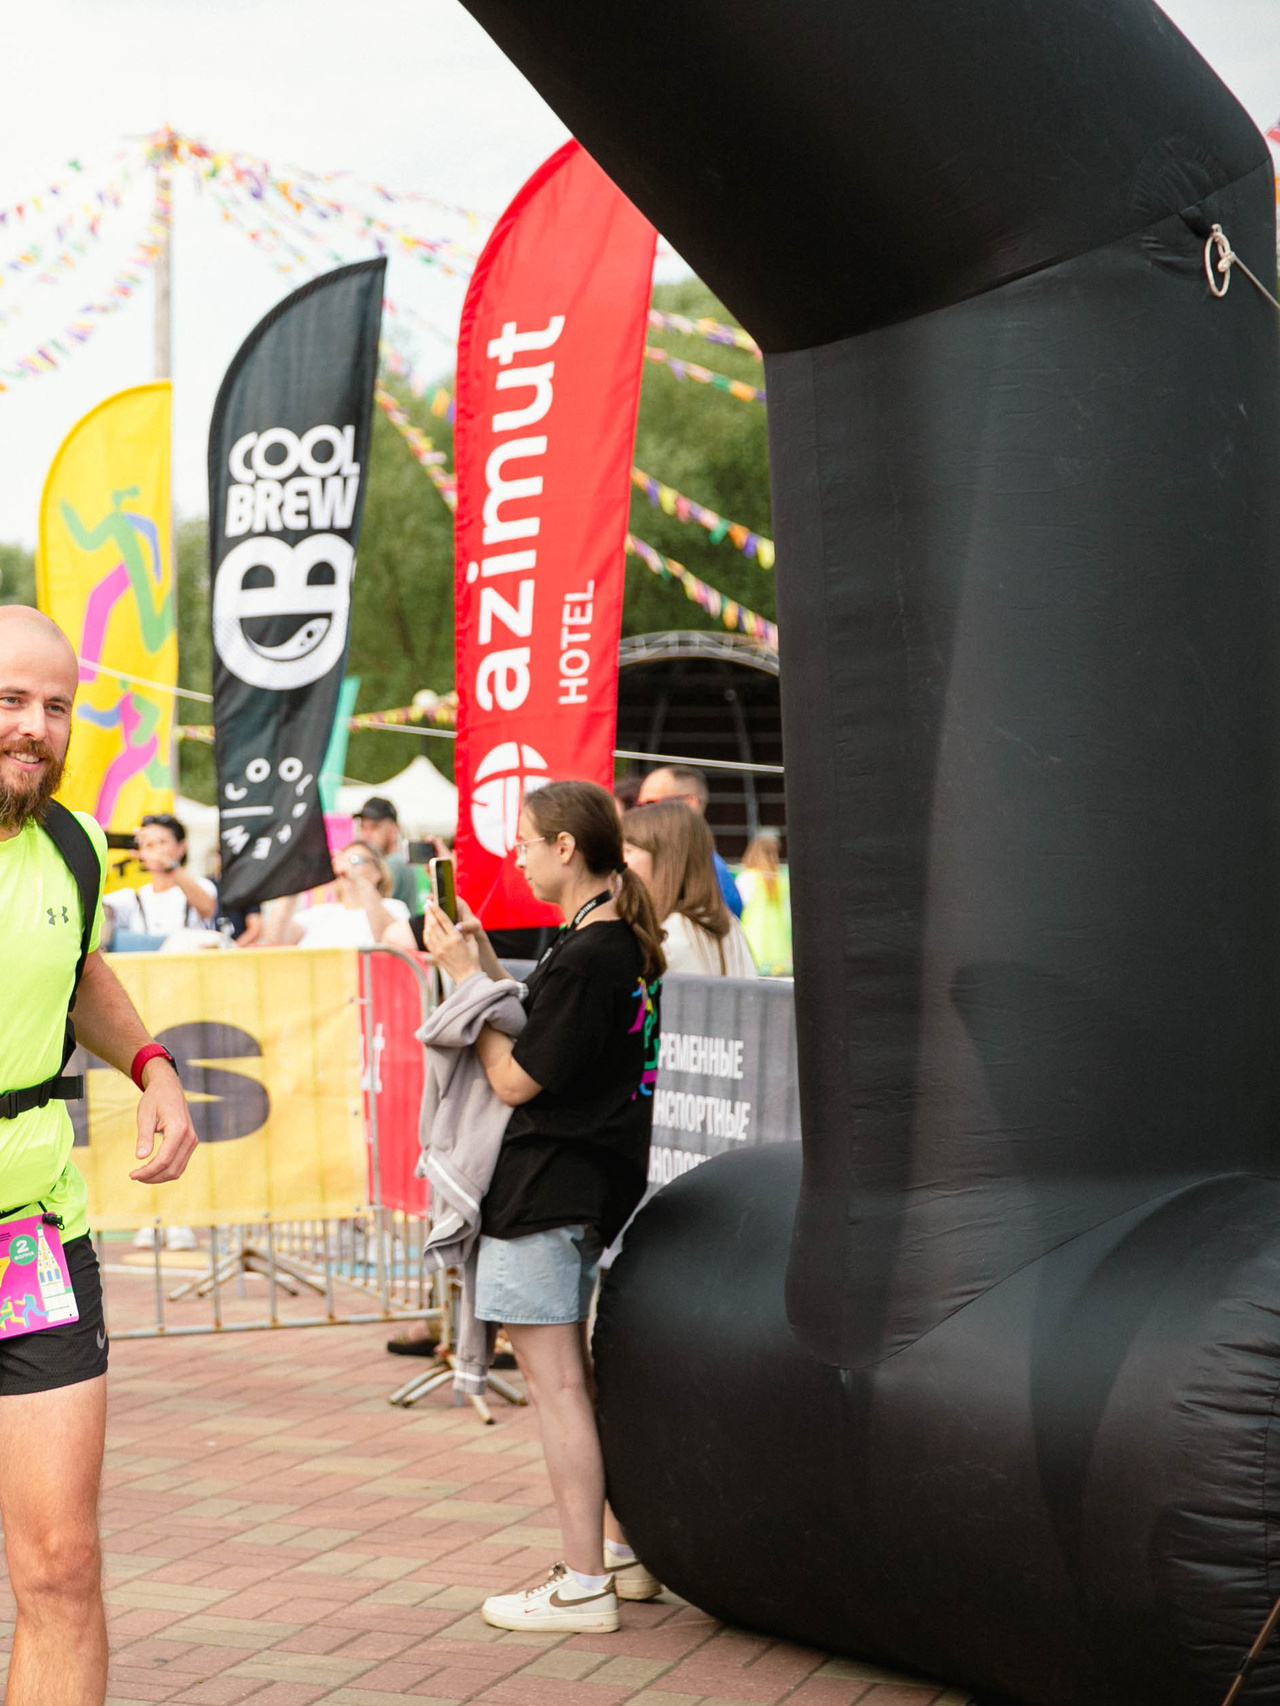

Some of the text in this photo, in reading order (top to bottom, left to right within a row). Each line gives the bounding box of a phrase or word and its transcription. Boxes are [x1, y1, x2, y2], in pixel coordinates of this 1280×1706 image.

[228, 424, 360, 485] COOL
[225, 475, 360, 538] BREW
[467, 315, 566, 711] azimut
[558, 579, 595, 705] HOTEL
[16, 1239, 29, 1254] 2
